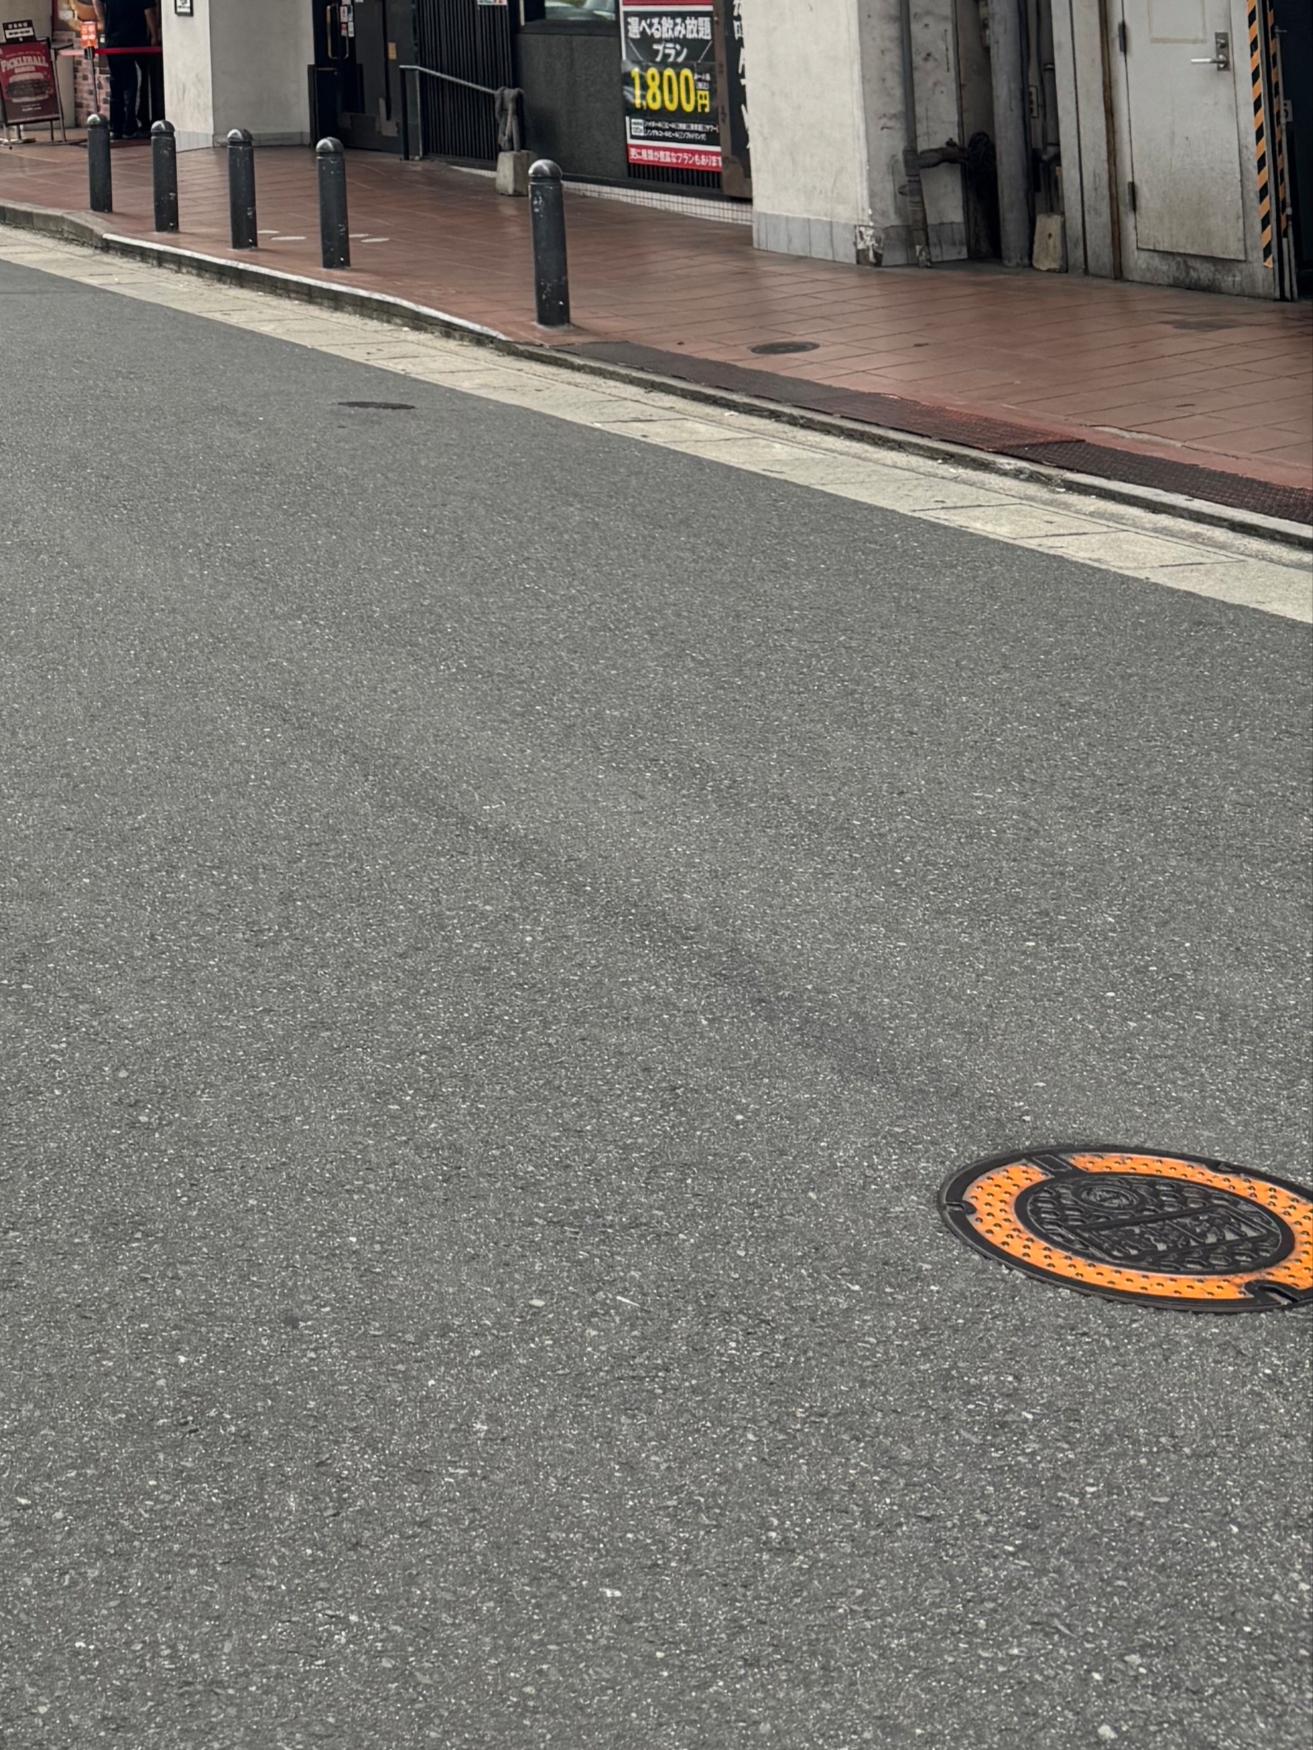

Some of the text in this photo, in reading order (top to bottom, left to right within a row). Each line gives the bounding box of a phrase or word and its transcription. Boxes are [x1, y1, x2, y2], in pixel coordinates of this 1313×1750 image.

[627, 16, 711, 40] 選べる飲み放題
[652, 41, 687, 63] プラン
